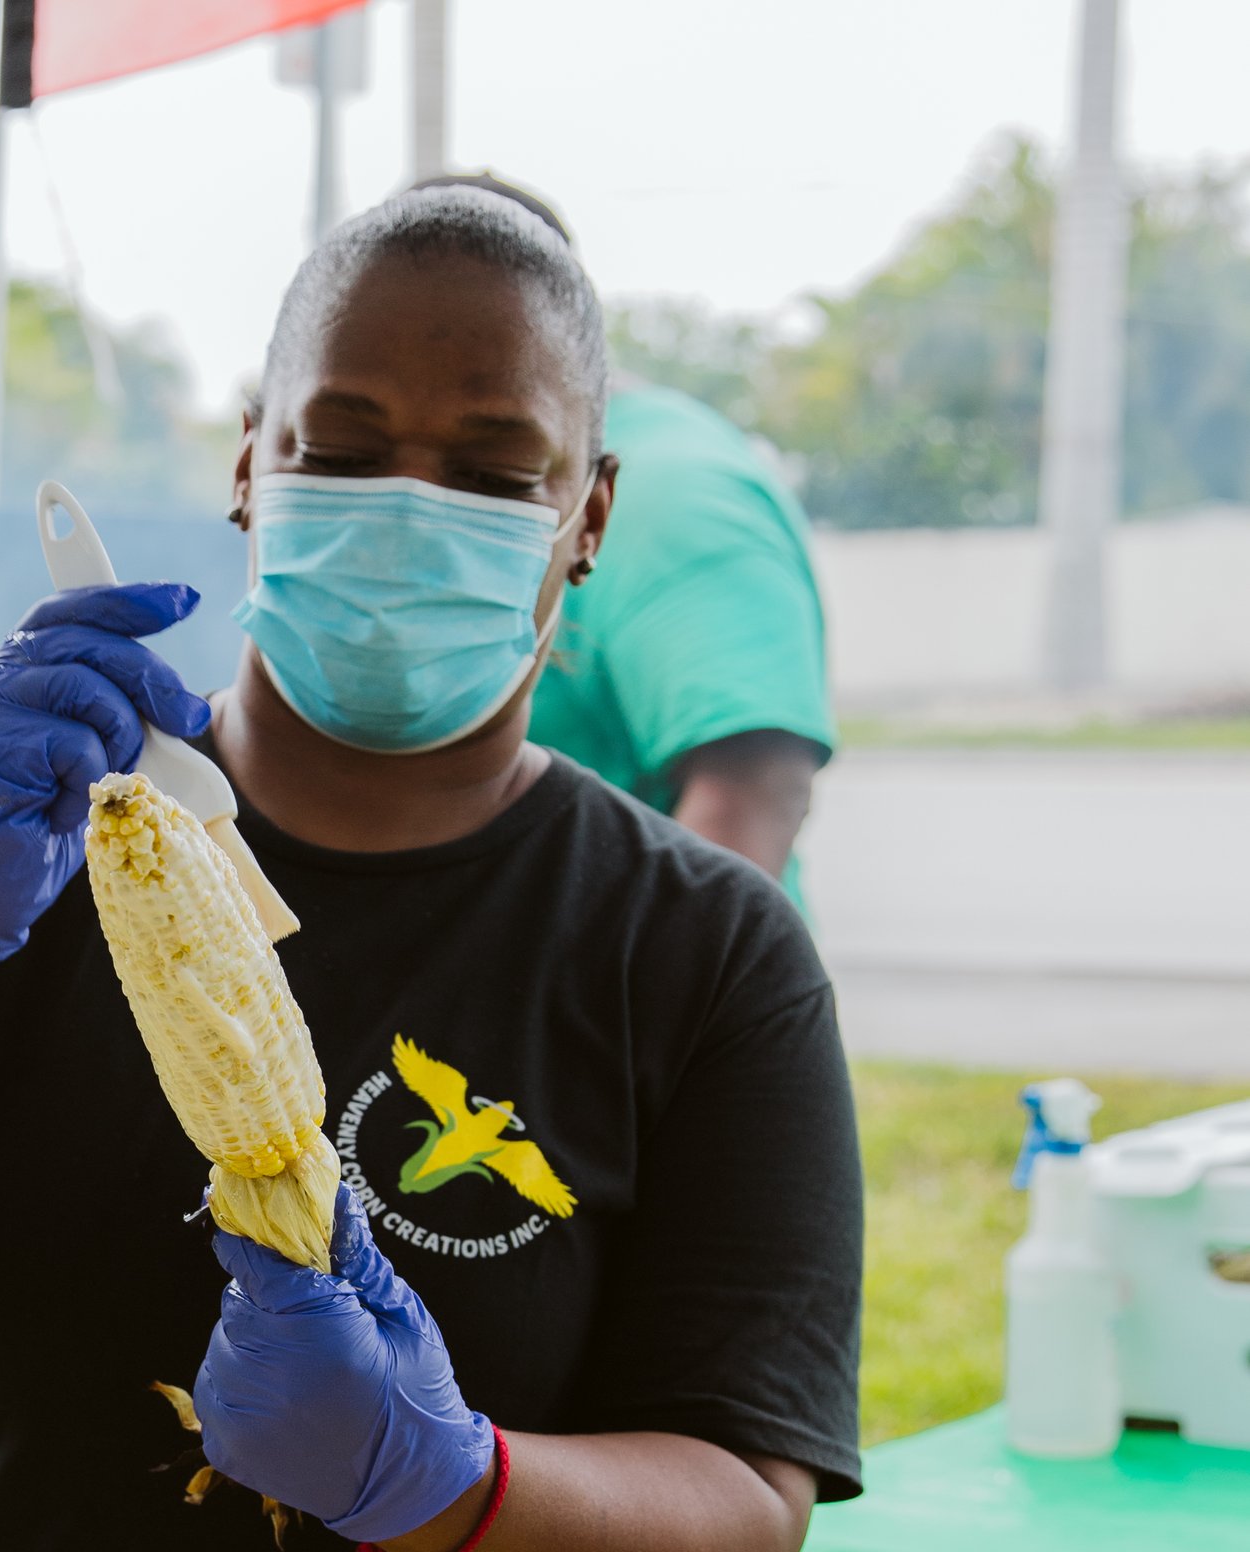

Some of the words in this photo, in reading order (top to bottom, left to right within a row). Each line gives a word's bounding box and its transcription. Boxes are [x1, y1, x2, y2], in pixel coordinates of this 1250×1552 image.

[336, 1070, 392, 1161] HEAVENLY
[340, 1160, 387, 1217] CORN
[382, 1211, 509, 1259] CREATIONS
[510, 1213, 551, 1249] INC.
